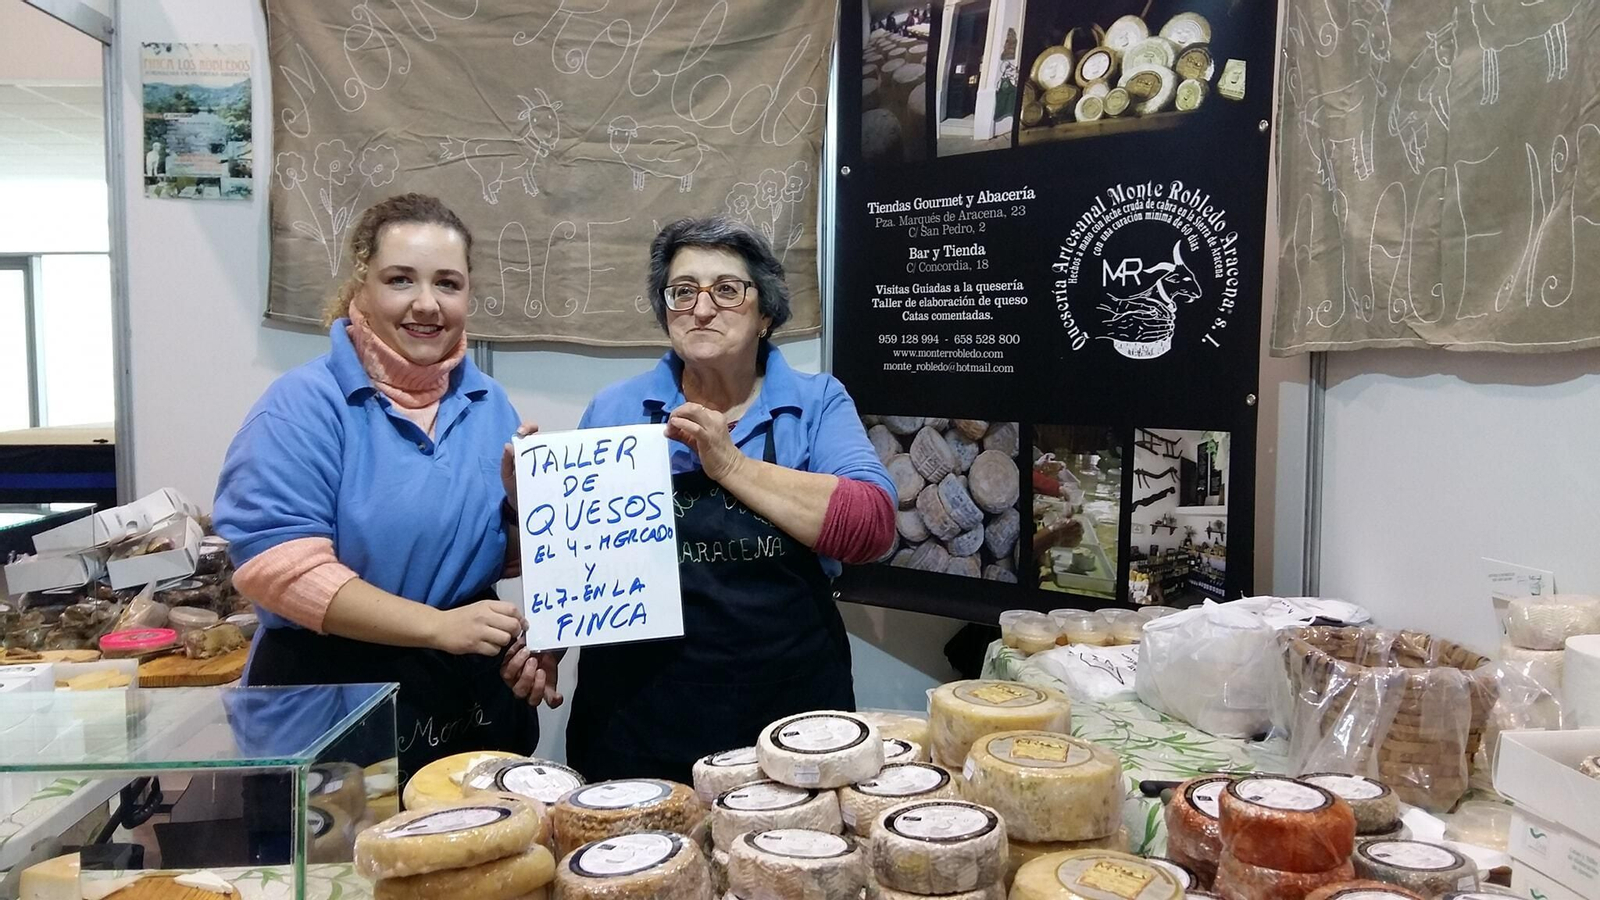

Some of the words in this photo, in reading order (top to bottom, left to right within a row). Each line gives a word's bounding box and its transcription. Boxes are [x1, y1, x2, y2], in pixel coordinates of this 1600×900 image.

[867, 200, 911, 214] Tiendas
[913, 194, 963, 210] Gourmet
[966, 195, 974, 208] y
[977, 185, 1036, 204] Abacería
[1106, 180, 1163, 206] Monte
[1122, 199, 1144, 213] cruda
[1145, 198, 1155, 209] de
[1156, 199, 1177, 213] cabra
[1167, 180, 1226, 232] Robledo
[1177, 207, 1188, 218] en
[875, 217, 896, 228] Pza.
[899, 212, 941, 227] Marqués
[943, 211, 956, 222] de
[958, 209, 1007, 221] Aracena,
[1011, 205, 1026, 216] 23
[1101, 207, 1122, 224] leche
[1185, 209, 1195, 222] la
[908, 227, 918, 238] C/
[920, 226, 939, 236] San
[942, 223, 975, 235] Pedro,
[979, 222, 986, 232] 2
[1051, 195, 1107, 274] Artesanal
[1091, 219, 1105, 234] con
[1093, 241, 1104, 256] con
[1100, 227, 1114, 242] una
[1111, 211, 1143, 230] curación
[1172, 216, 1183, 229] de
[1180, 223, 1193, 236] 60
[1192, 216, 1212, 239] Sierra
[1078, 231, 1094, 252] mano
[1206, 235, 1218, 247] de
[909, 247, 930, 259] Bar
[932, 249, 940, 261] y
[943, 243, 986, 257] Tienda
[906, 262, 916, 273] C/
[918, 260, 972, 272] Concordia,
[977, 259, 989, 270] 18
[1068, 257, 1081, 284] Hechos
[1211, 247, 1223, 278] Aracena
[875, 284, 909, 294] Visitas
[912, 283, 951, 294] Guiadas
[953, 284, 960, 292] a
[963, 281, 973, 292] la
[976, 279, 1024, 294] quesería
[872, 298, 902, 308] Taller
[905, 297, 916, 307] de
[919, 295, 975, 307] elaboración
[978, 295, 991, 305] de
[994, 296, 1028, 308] queso
[902, 311, 929, 320] Catas
[931, 310, 993, 320] comentadas.
[1051, 280, 1090, 351] Quesería
[878, 334, 897, 344] 959
[901, 334, 918, 344] 128
[921, 334, 939, 344] 994
[954, 334, 973, 344] 658
[975, 334, 995, 344] 528
[998, 334, 1020, 344] 800
[893, 348, 1004, 358] www.monterrobledo.com
[883, 361, 1014, 373] monte_robledo@hotmail.com
[521, 435, 637, 477] TALLER
[563, 473, 599, 497] DE
[526, 492, 665, 537] QUESOS
[534, 545, 555, 564] EL
[600, 524, 673, 549] MERCADO
[679, 536, 786, 563] ARACENA
[585, 563, 596, 582] Y
[612, 577, 645, 597] LA
[557, 602, 647, 641] FINCA
